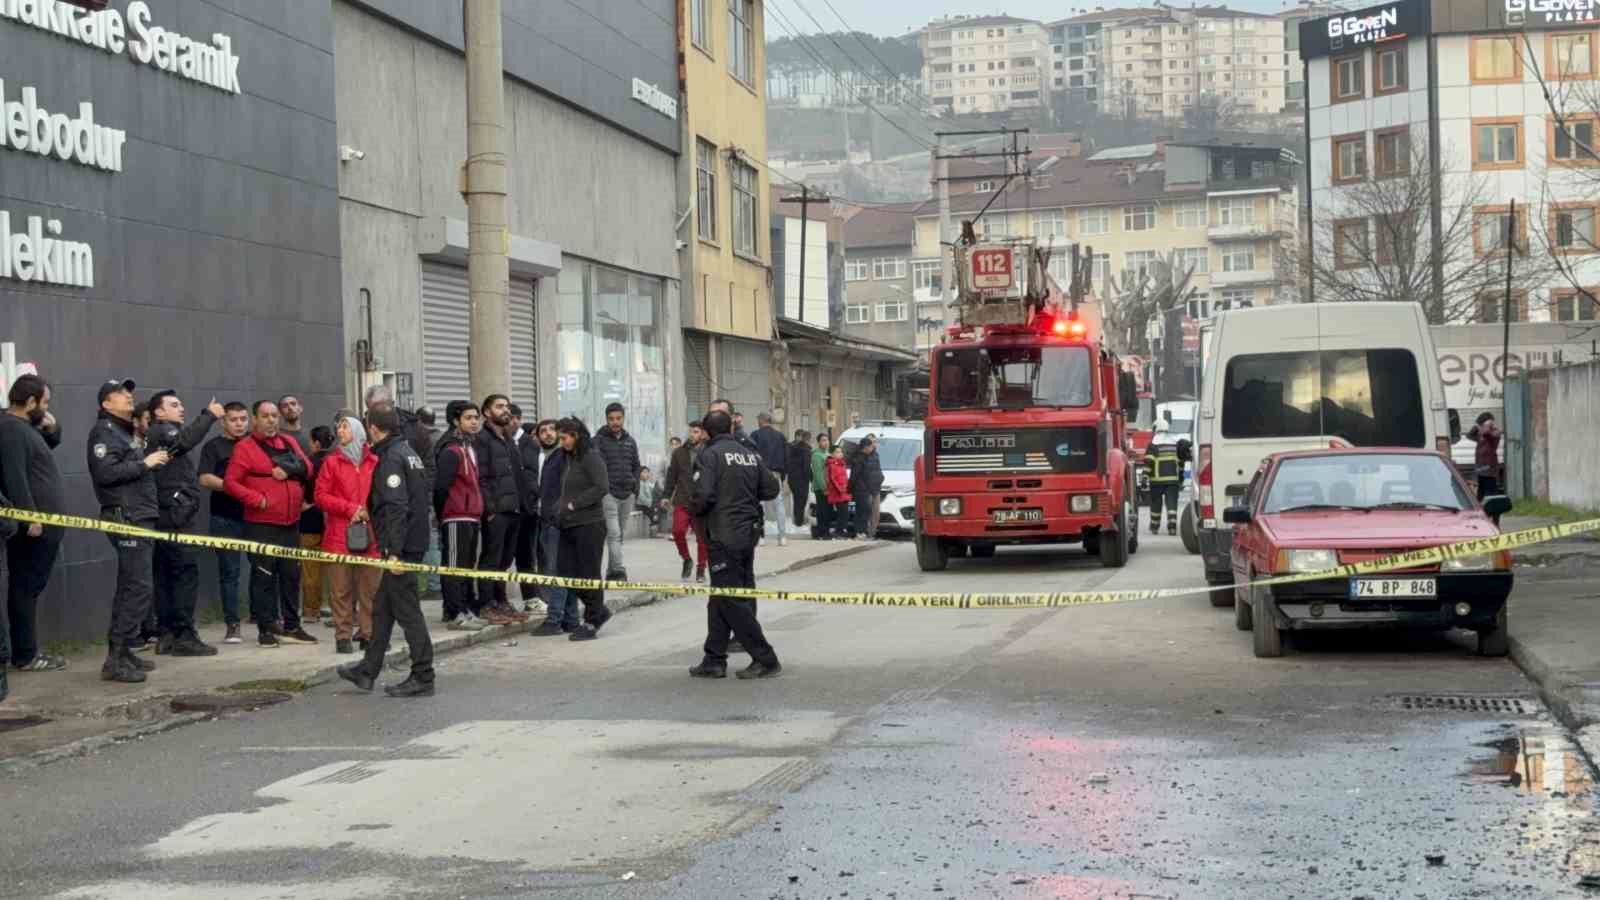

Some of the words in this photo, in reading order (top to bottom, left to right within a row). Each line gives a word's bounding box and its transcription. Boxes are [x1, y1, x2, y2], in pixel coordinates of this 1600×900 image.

[1545, 11, 1594, 23] PLAZA
[1353, 28, 1387, 44] PLAZA
[127, 1, 241, 94] Seramik
[977, 254, 1006, 273] 112
[1025, 511, 1039, 521] 110
[1359, 581, 1374, 595] 74
[1382, 581, 1400, 595] BP
[1411, 580, 1434, 594] 848
[876, 596, 917, 607] KAZA
